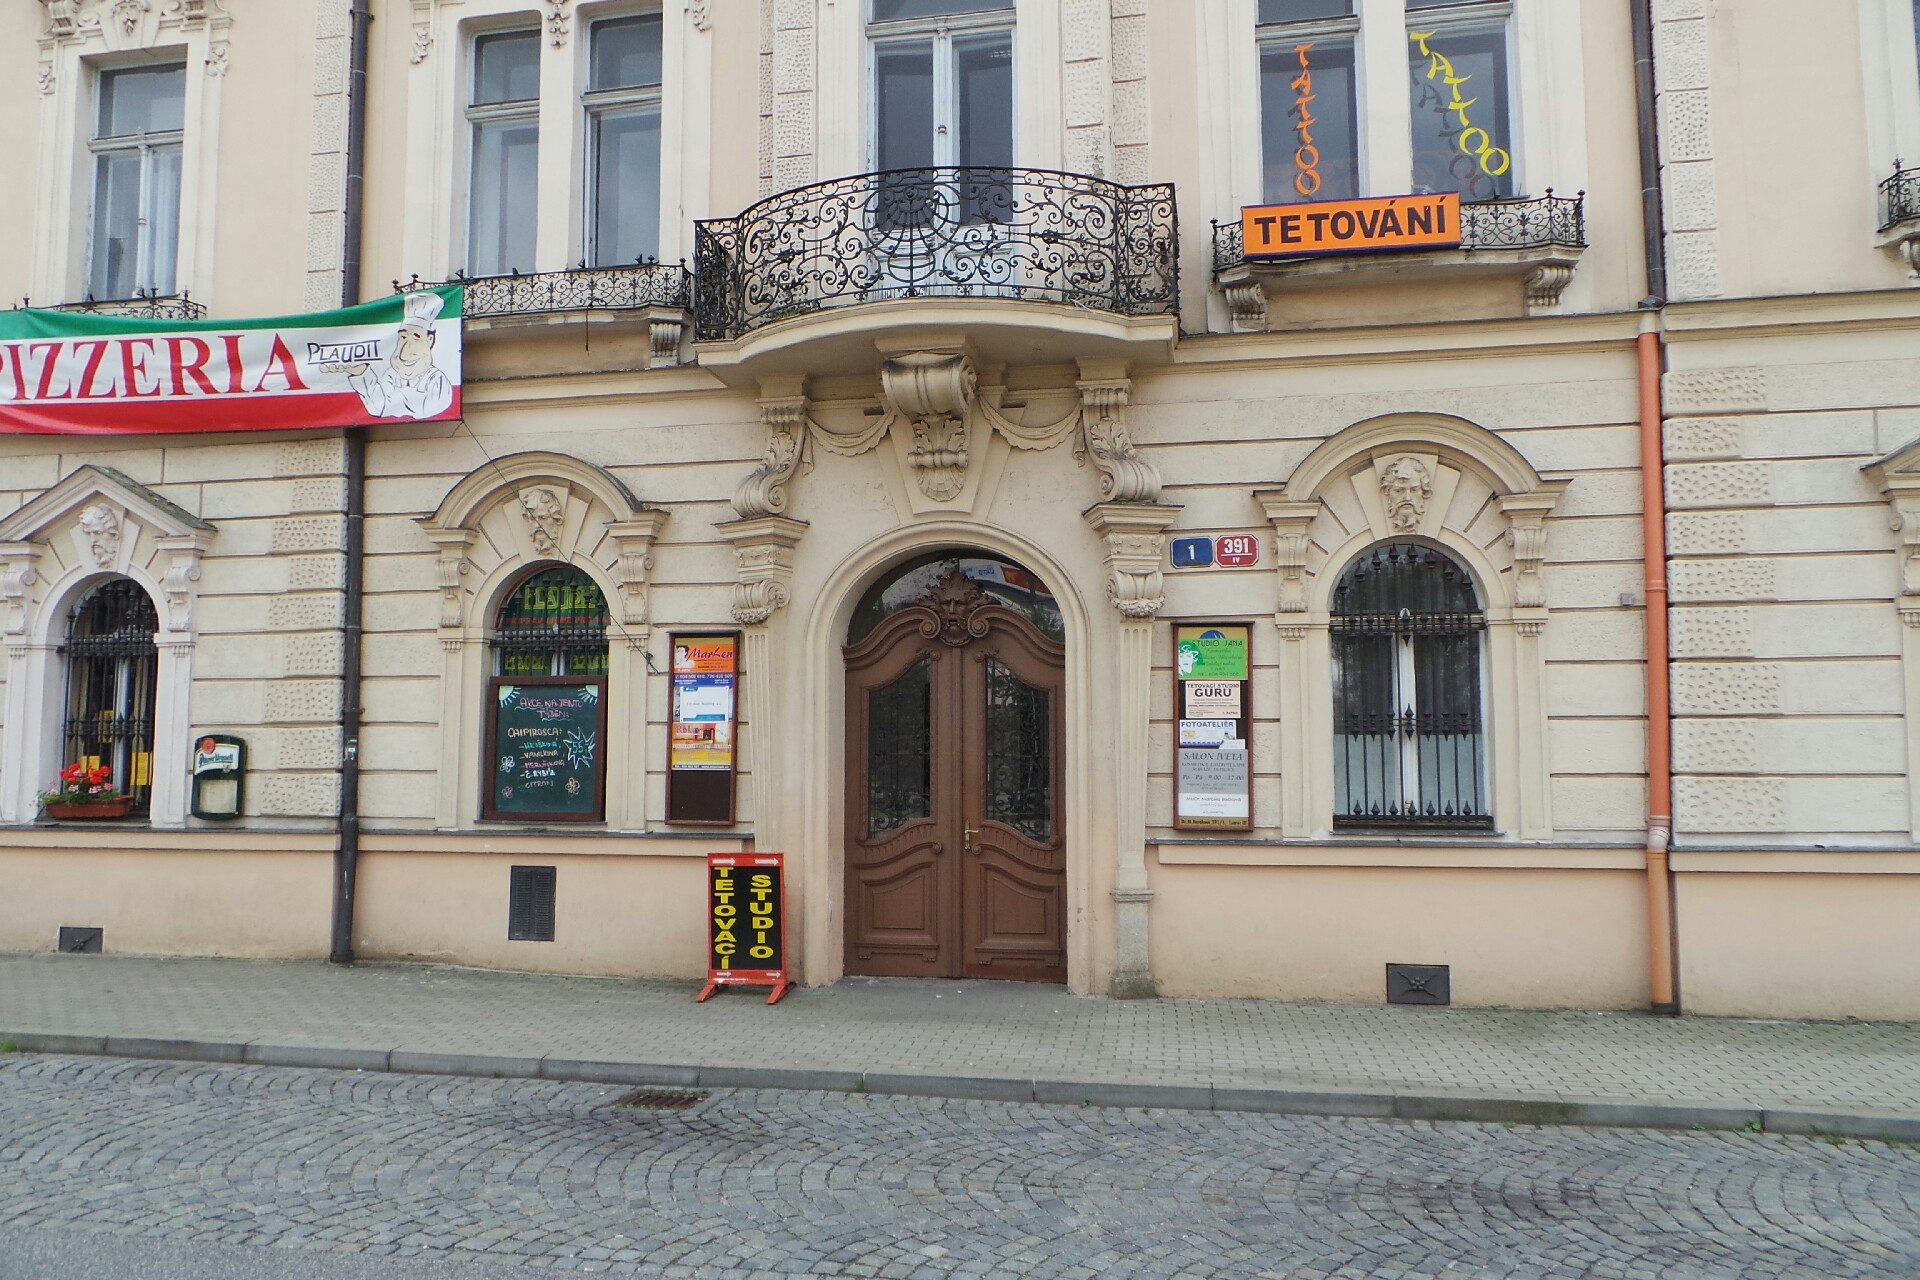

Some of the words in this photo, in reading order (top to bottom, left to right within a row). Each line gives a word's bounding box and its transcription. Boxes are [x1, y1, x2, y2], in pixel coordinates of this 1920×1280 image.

[1410, 29, 1510, 176] TATTOO
[1290, 42, 1321, 195] TATTOO
[1254, 196, 1447, 245] TETOVÁNÍ
[307, 339, 381, 365] PLAUDIT
[0, 332, 310, 401] IZZERIA
[1188, 544, 1195, 560] 1
[1224, 537, 1249, 554] 391
[1232, 556, 1241, 564] IV
[1224, 639, 1243, 647] JANA
[1194, 688, 1232, 697] GURU
[1184, 752, 1214, 760] SALON
[1216, 752, 1243, 760] IVETA
[713, 866, 737, 970] TETOVACÍ
[749, 874, 774, 959] STUDIO
